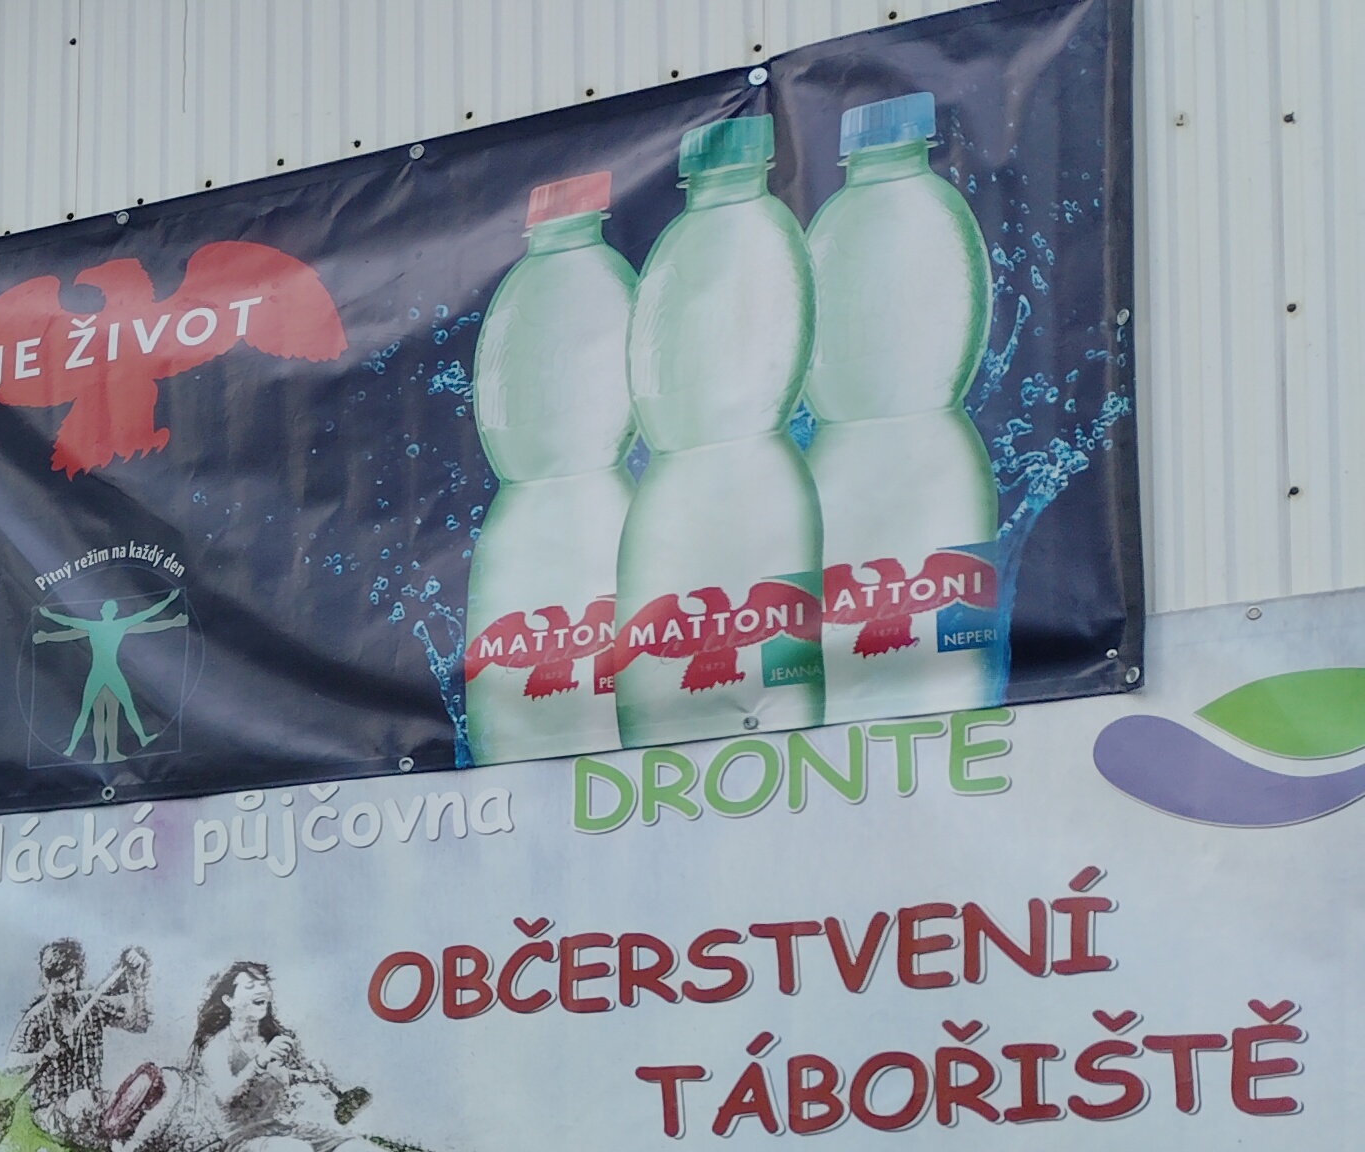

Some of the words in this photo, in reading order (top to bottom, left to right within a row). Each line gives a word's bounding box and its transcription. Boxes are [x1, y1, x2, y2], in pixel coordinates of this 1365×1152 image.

[65, 296, 263, 371] ŽIVOT
[35, 561, 72, 591] Pitný
[75, 549, 109, 571] režim
[112, 546, 126, 559] na
[129, 540, 164, 567] každý
[163, 553, 185, 578] den
[821, 571, 982, 613] ATTONI
[628, 602, 804, 649] MATTONI
[572, 709, 1015, 834] DRONTE
[192, 784, 515, 886] půjčovna
[366, 866, 1117, 1023] OBČERSTVENÍ
[636, 1000, 1305, 1141] TÁBOŘIŠTĚ
